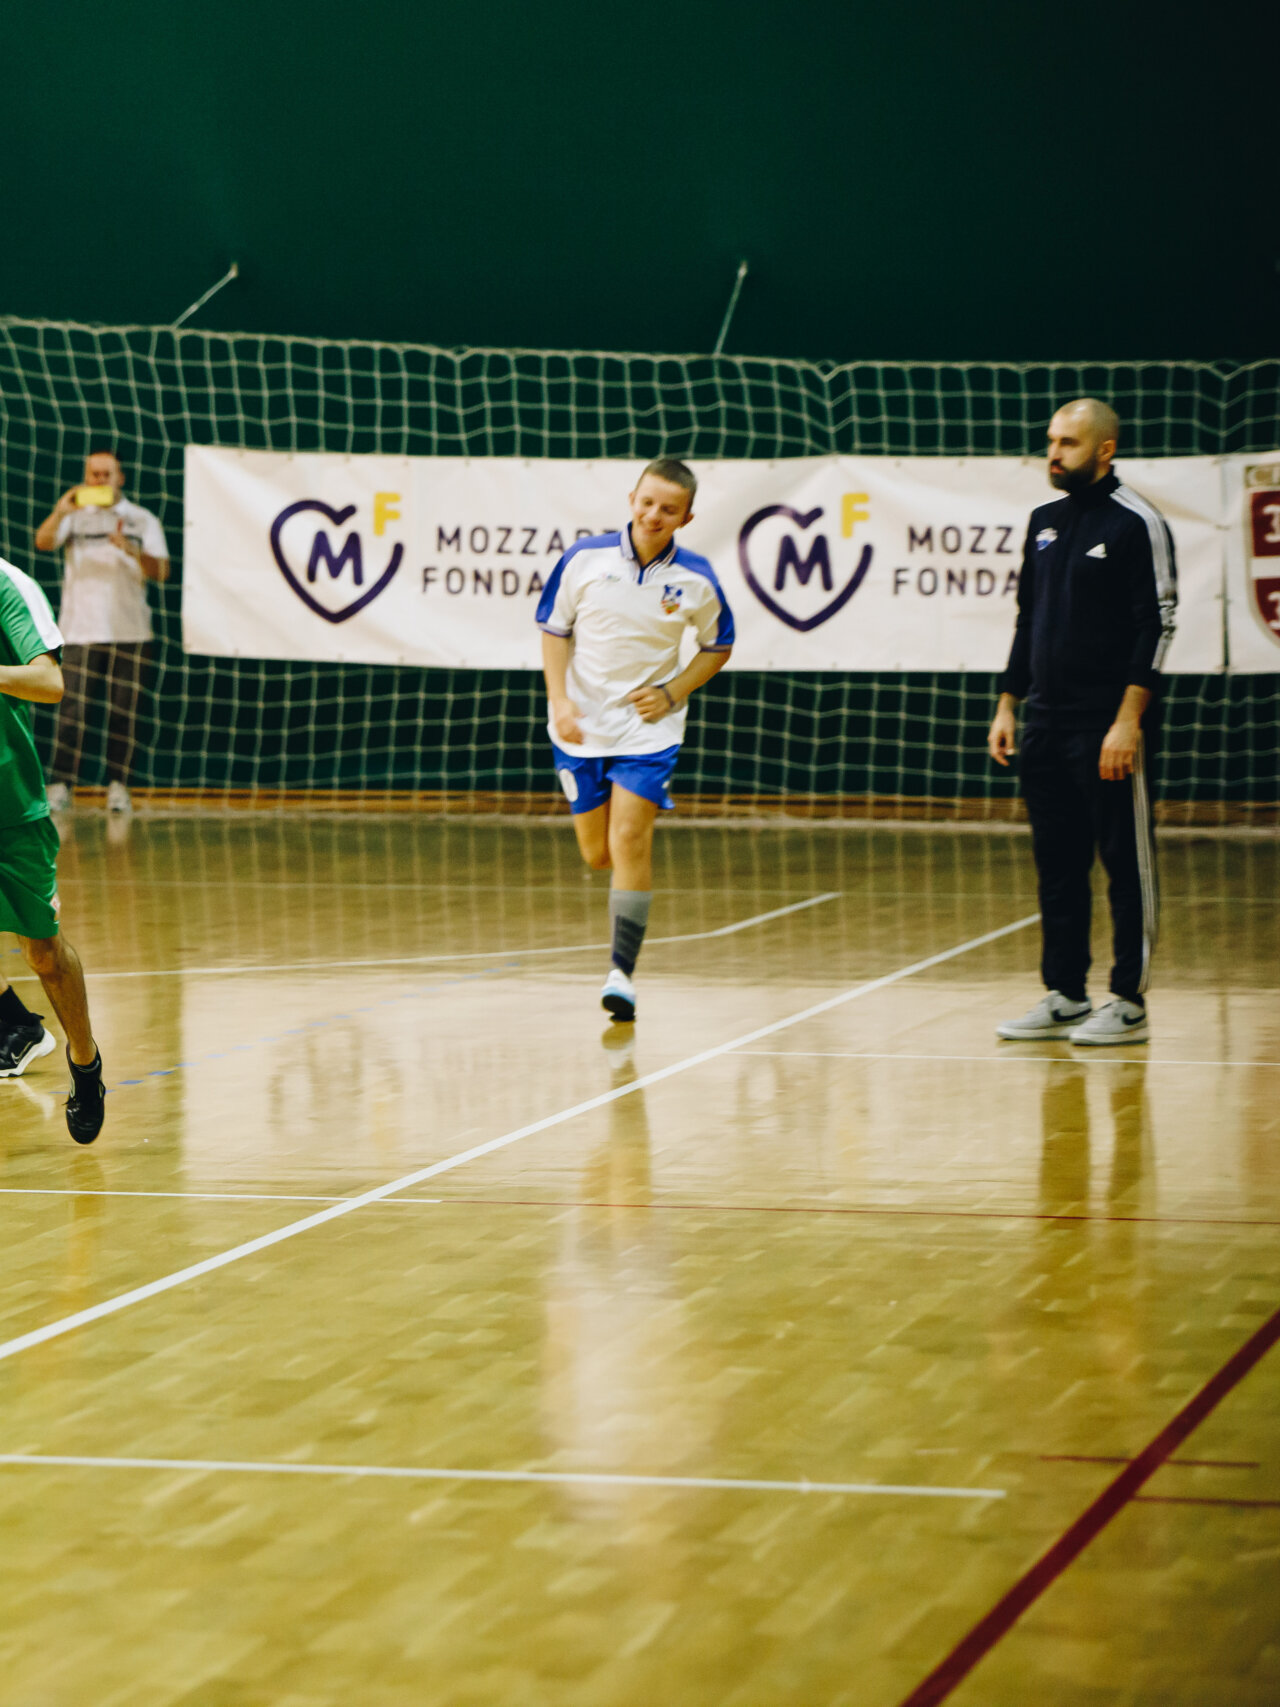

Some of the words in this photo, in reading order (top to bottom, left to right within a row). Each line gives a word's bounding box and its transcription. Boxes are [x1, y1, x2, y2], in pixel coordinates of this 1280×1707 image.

[907, 525, 1013, 554] MOZZ
[422, 566, 544, 596] FONDA
[893, 567, 1019, 597] FONDA
